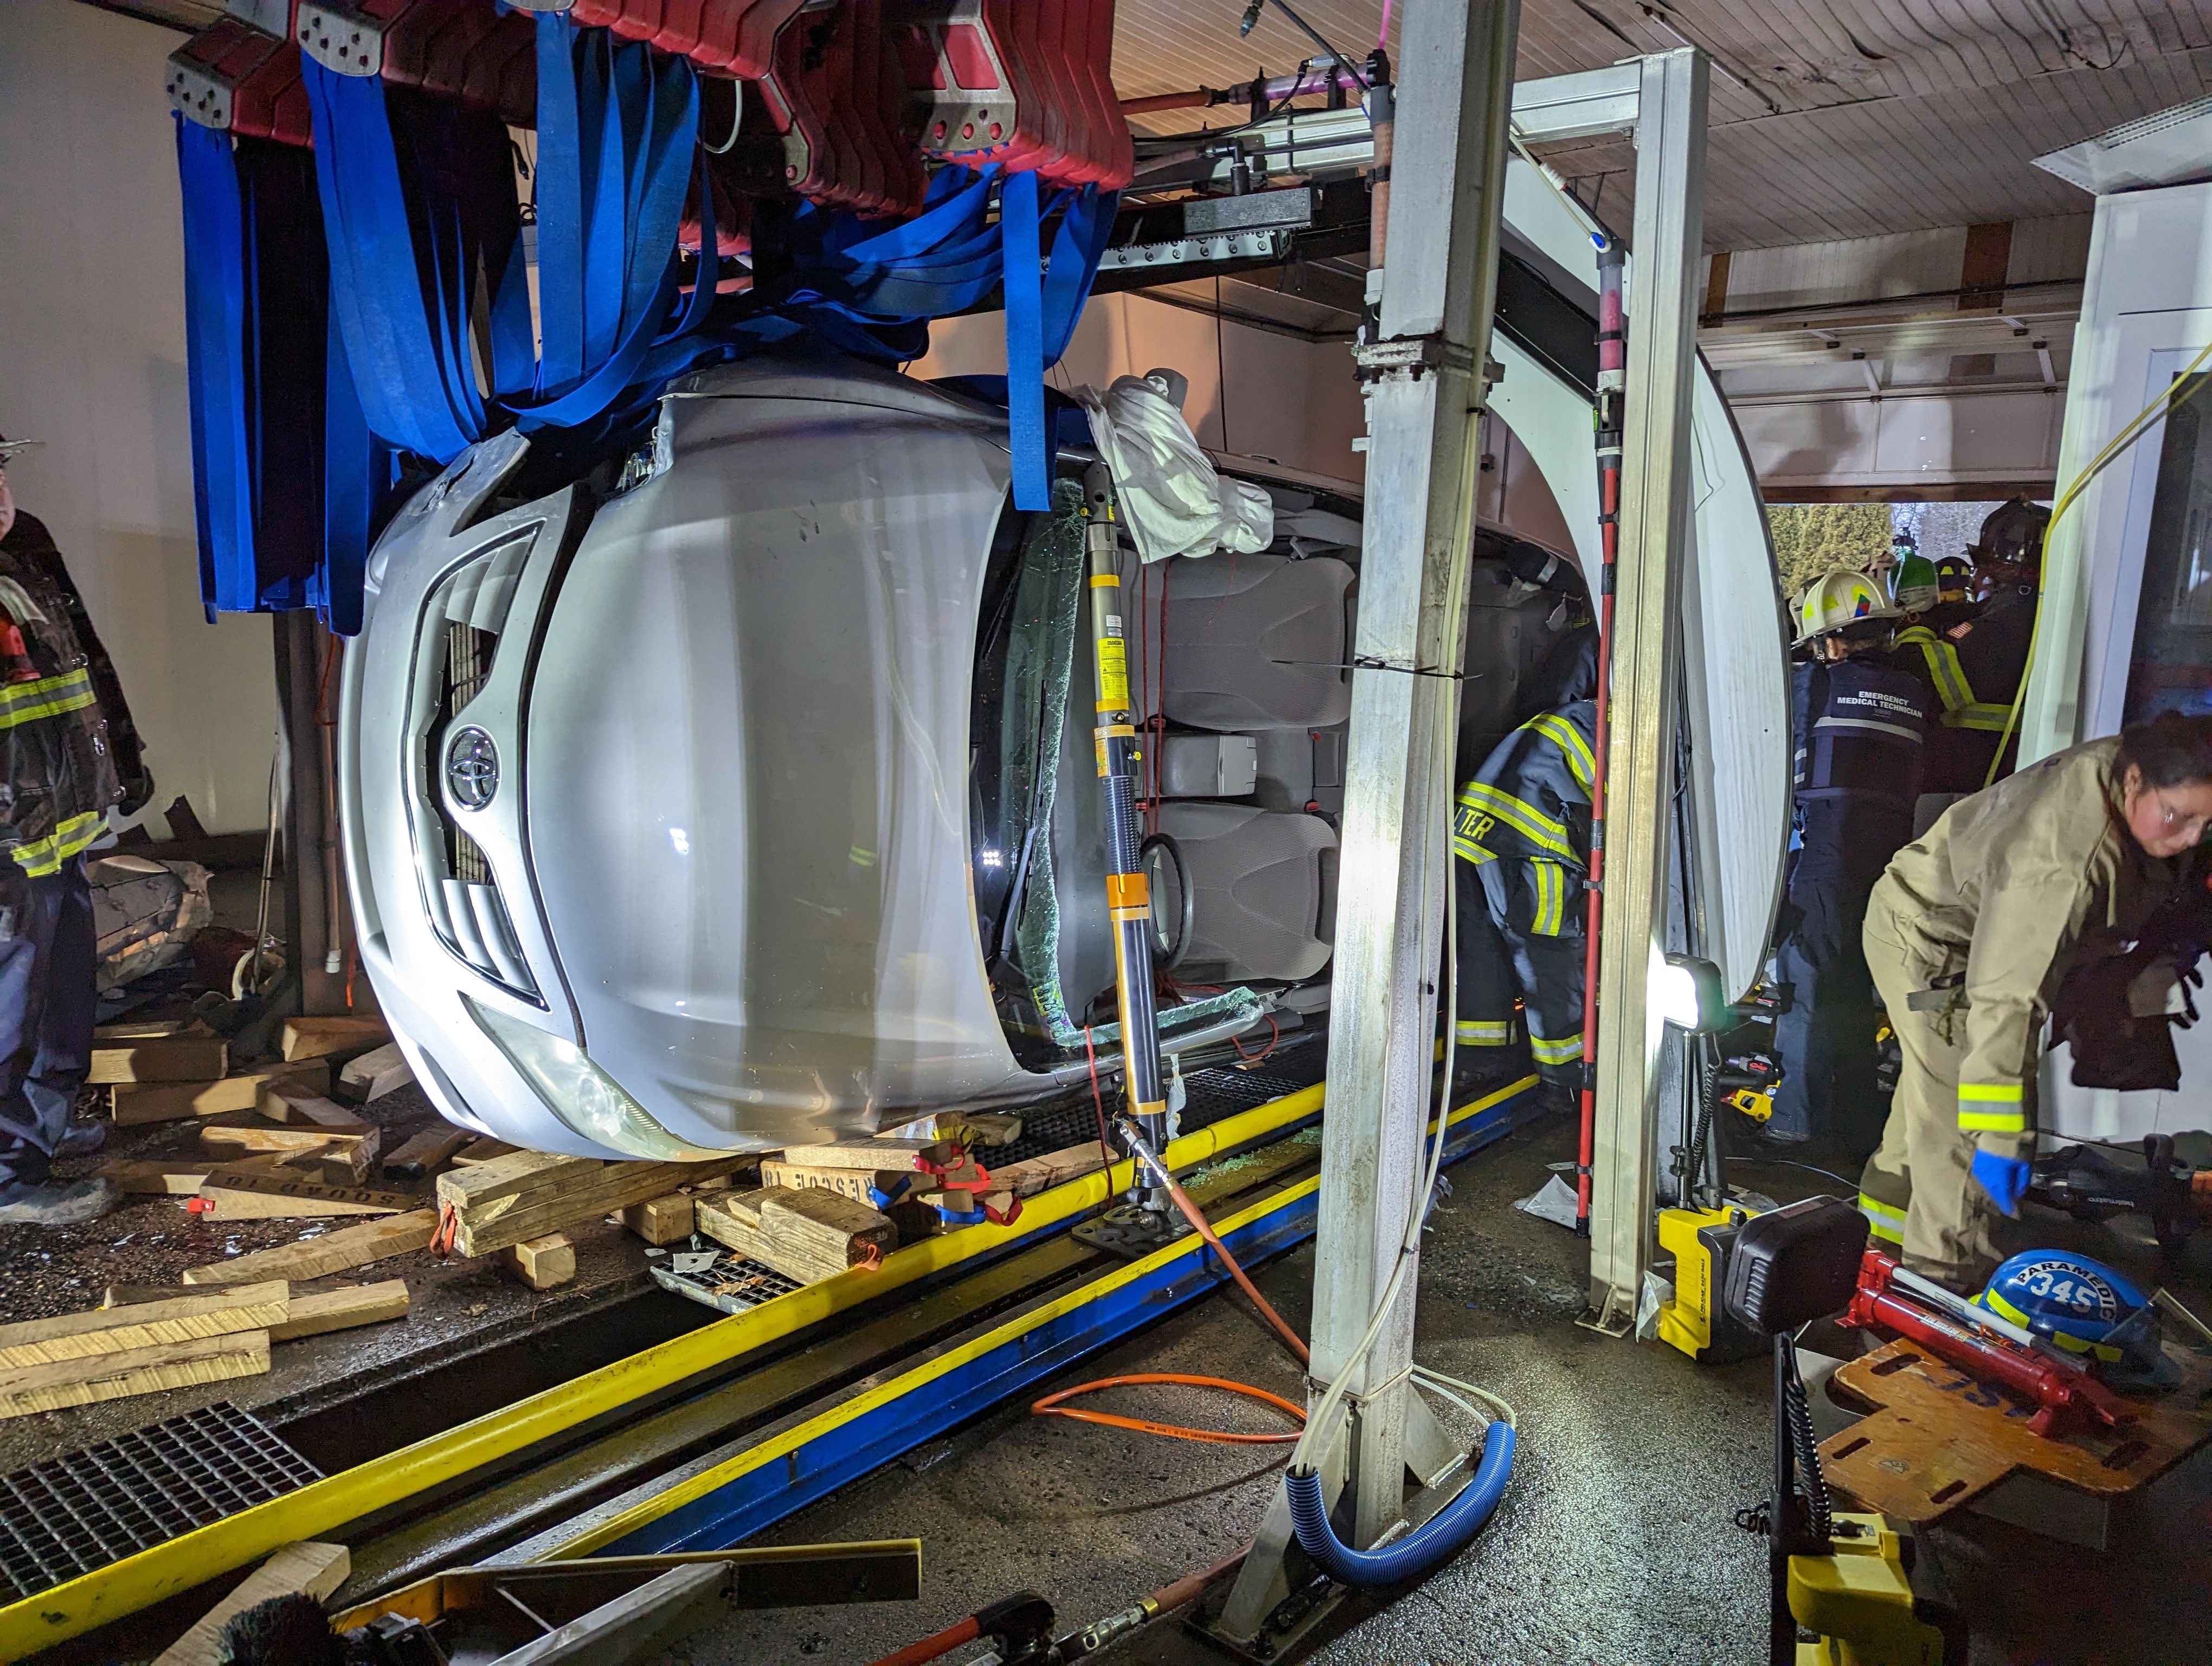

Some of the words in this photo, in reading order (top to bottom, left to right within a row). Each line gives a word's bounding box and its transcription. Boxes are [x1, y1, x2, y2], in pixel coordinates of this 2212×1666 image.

[1837, 697, 1879, 707] MEDICAL
[1879, 701, 1923, 719] TECHNICIAN
[1858, 691, 1909, 706] EMERGENCY
[2016, 1263, 2115, 1319] PARAMEDIC
[2030, 1272, 2098, 1313] 345
